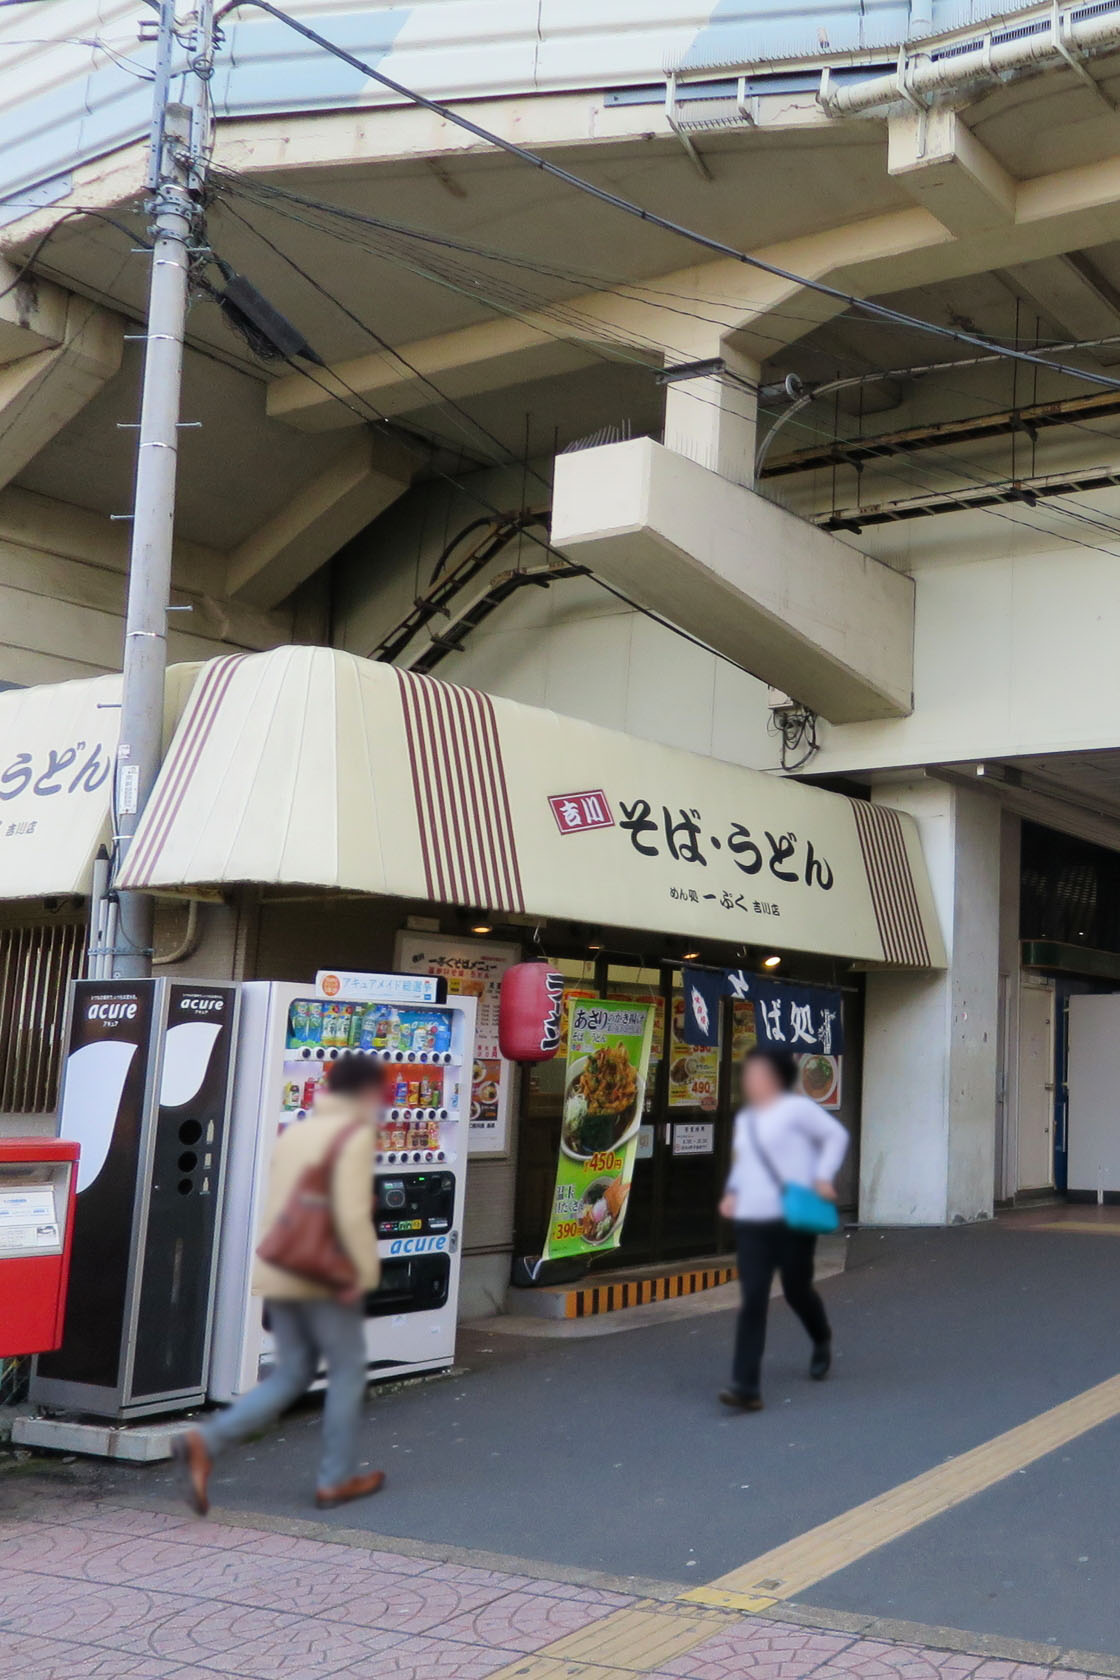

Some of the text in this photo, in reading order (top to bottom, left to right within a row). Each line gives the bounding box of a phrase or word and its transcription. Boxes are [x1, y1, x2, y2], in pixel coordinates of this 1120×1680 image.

[561, 797, 604, 827] 吉川
[752, 900, 780, 916] 吉川店
[88, 1003, 138, 1019] acure
[180, 999, 224, 1011] acure
[390, 1236, 447, 1254] acure
